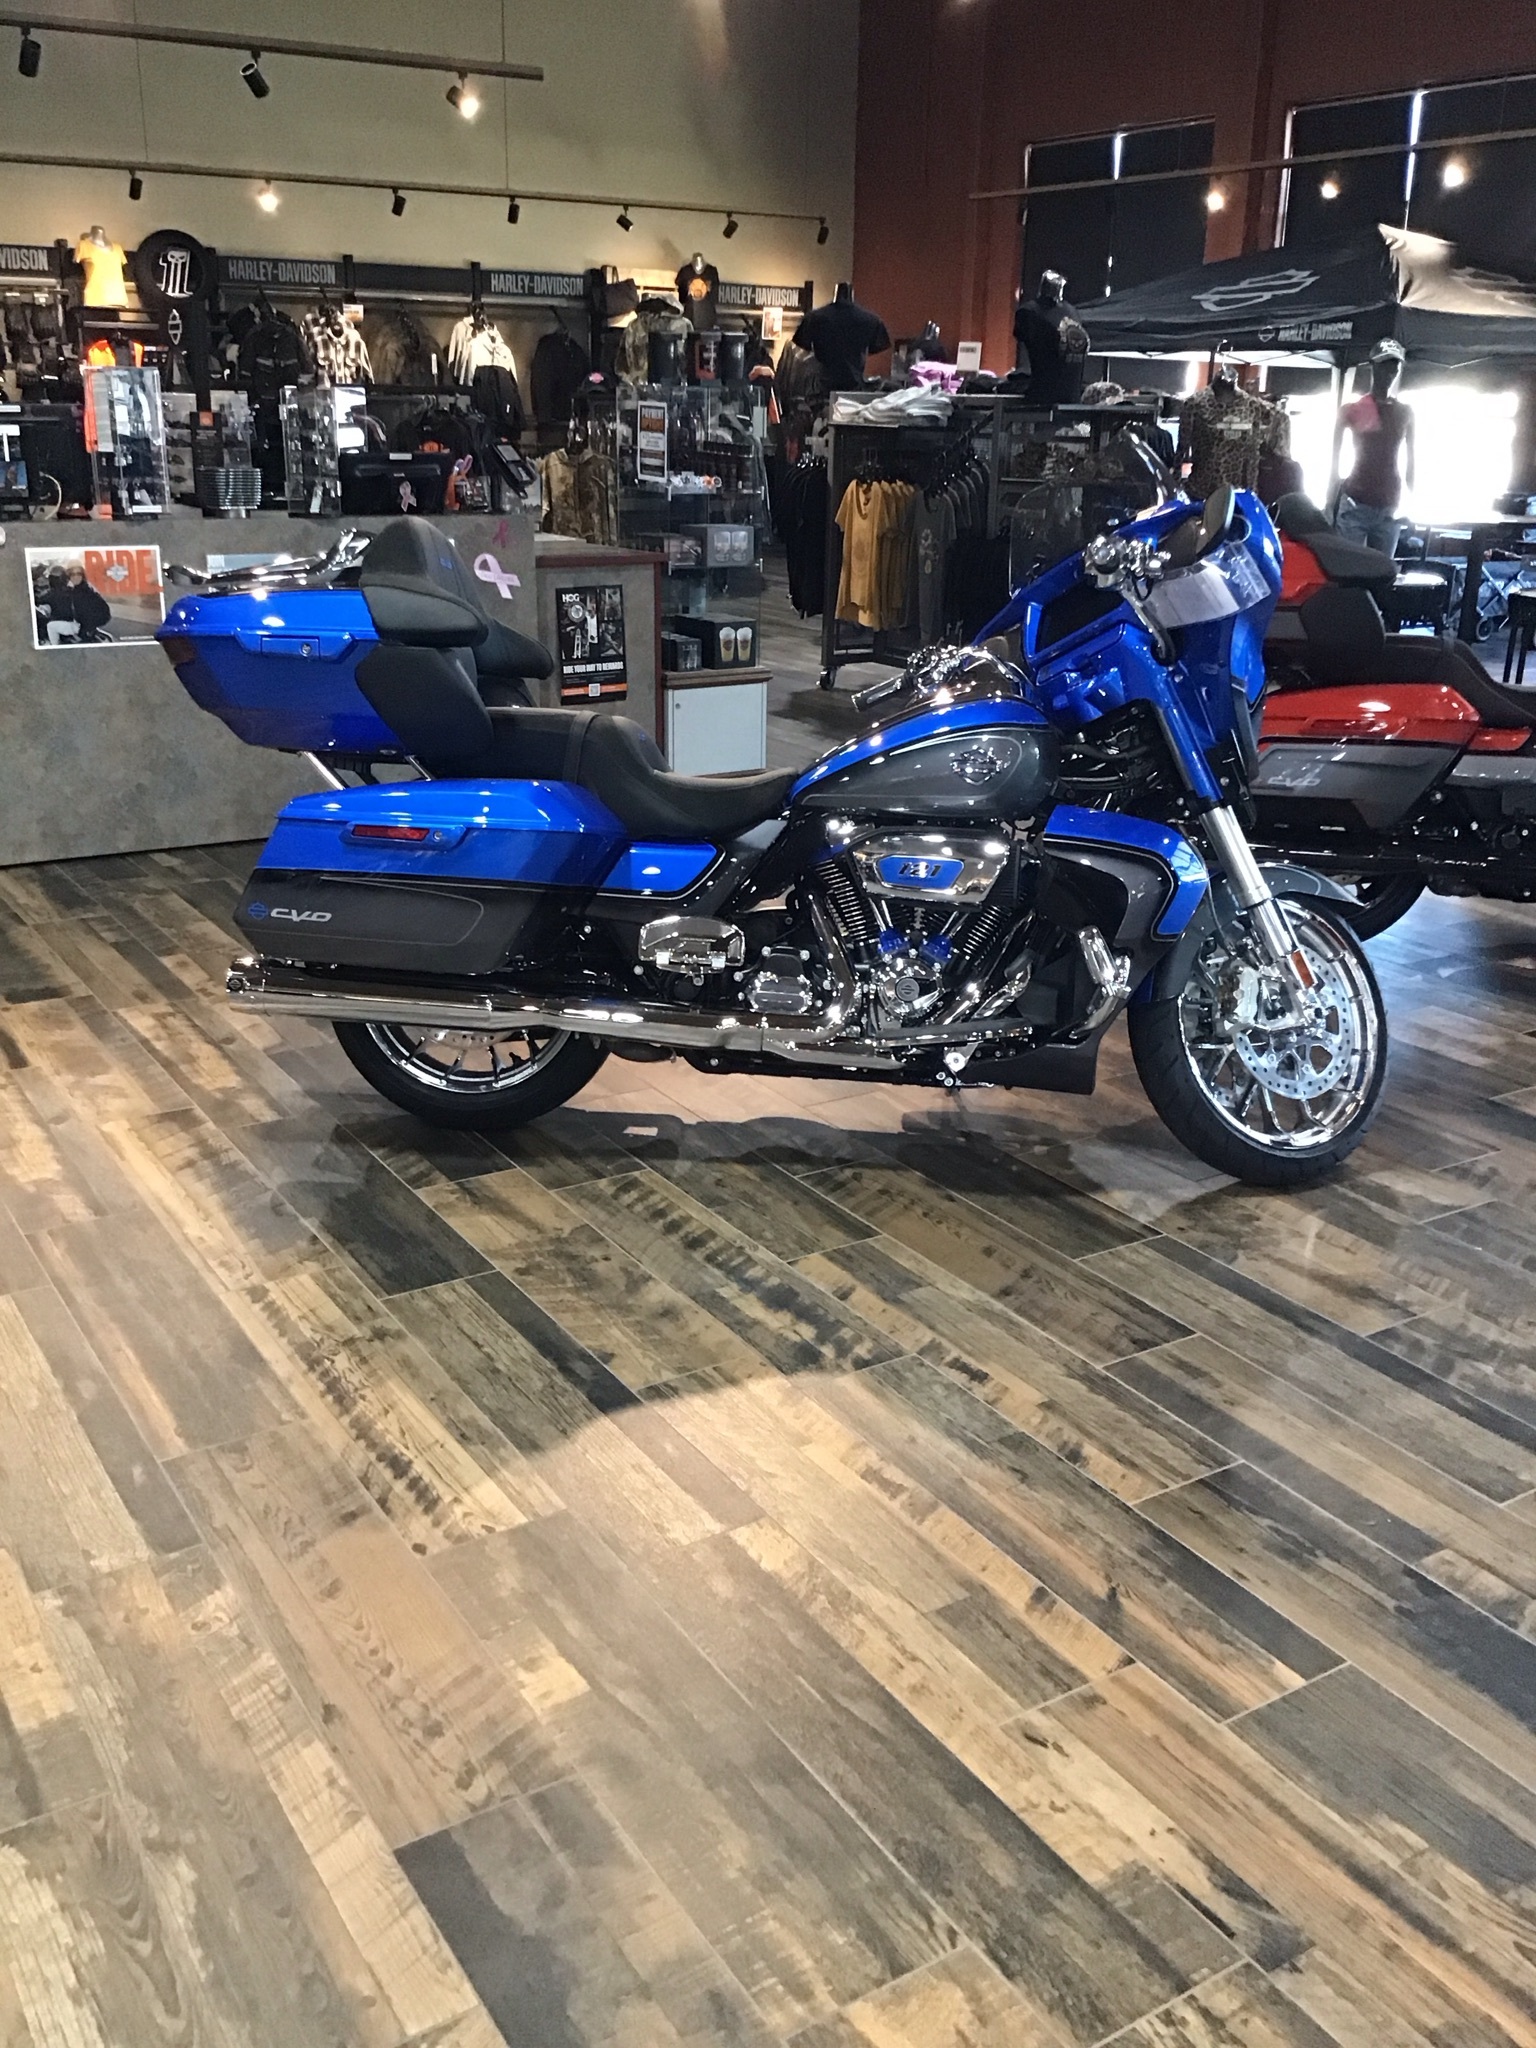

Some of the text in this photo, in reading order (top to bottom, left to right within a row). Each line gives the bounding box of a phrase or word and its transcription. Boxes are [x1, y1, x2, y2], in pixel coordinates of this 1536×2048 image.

[228, 259, 336, 285] HARLEY-DAVIDSON
[490, 272, 584, 296] HARLEY-DAVIDSON
[718, 285, 799, 307] HARLEY-DAVIDSON
[84, 549, 156, 594] RIDE
[561, 593, 580, 603] HOG
[898, 862, 943, 879] 121
[270, 907, 333, 922] CVO
